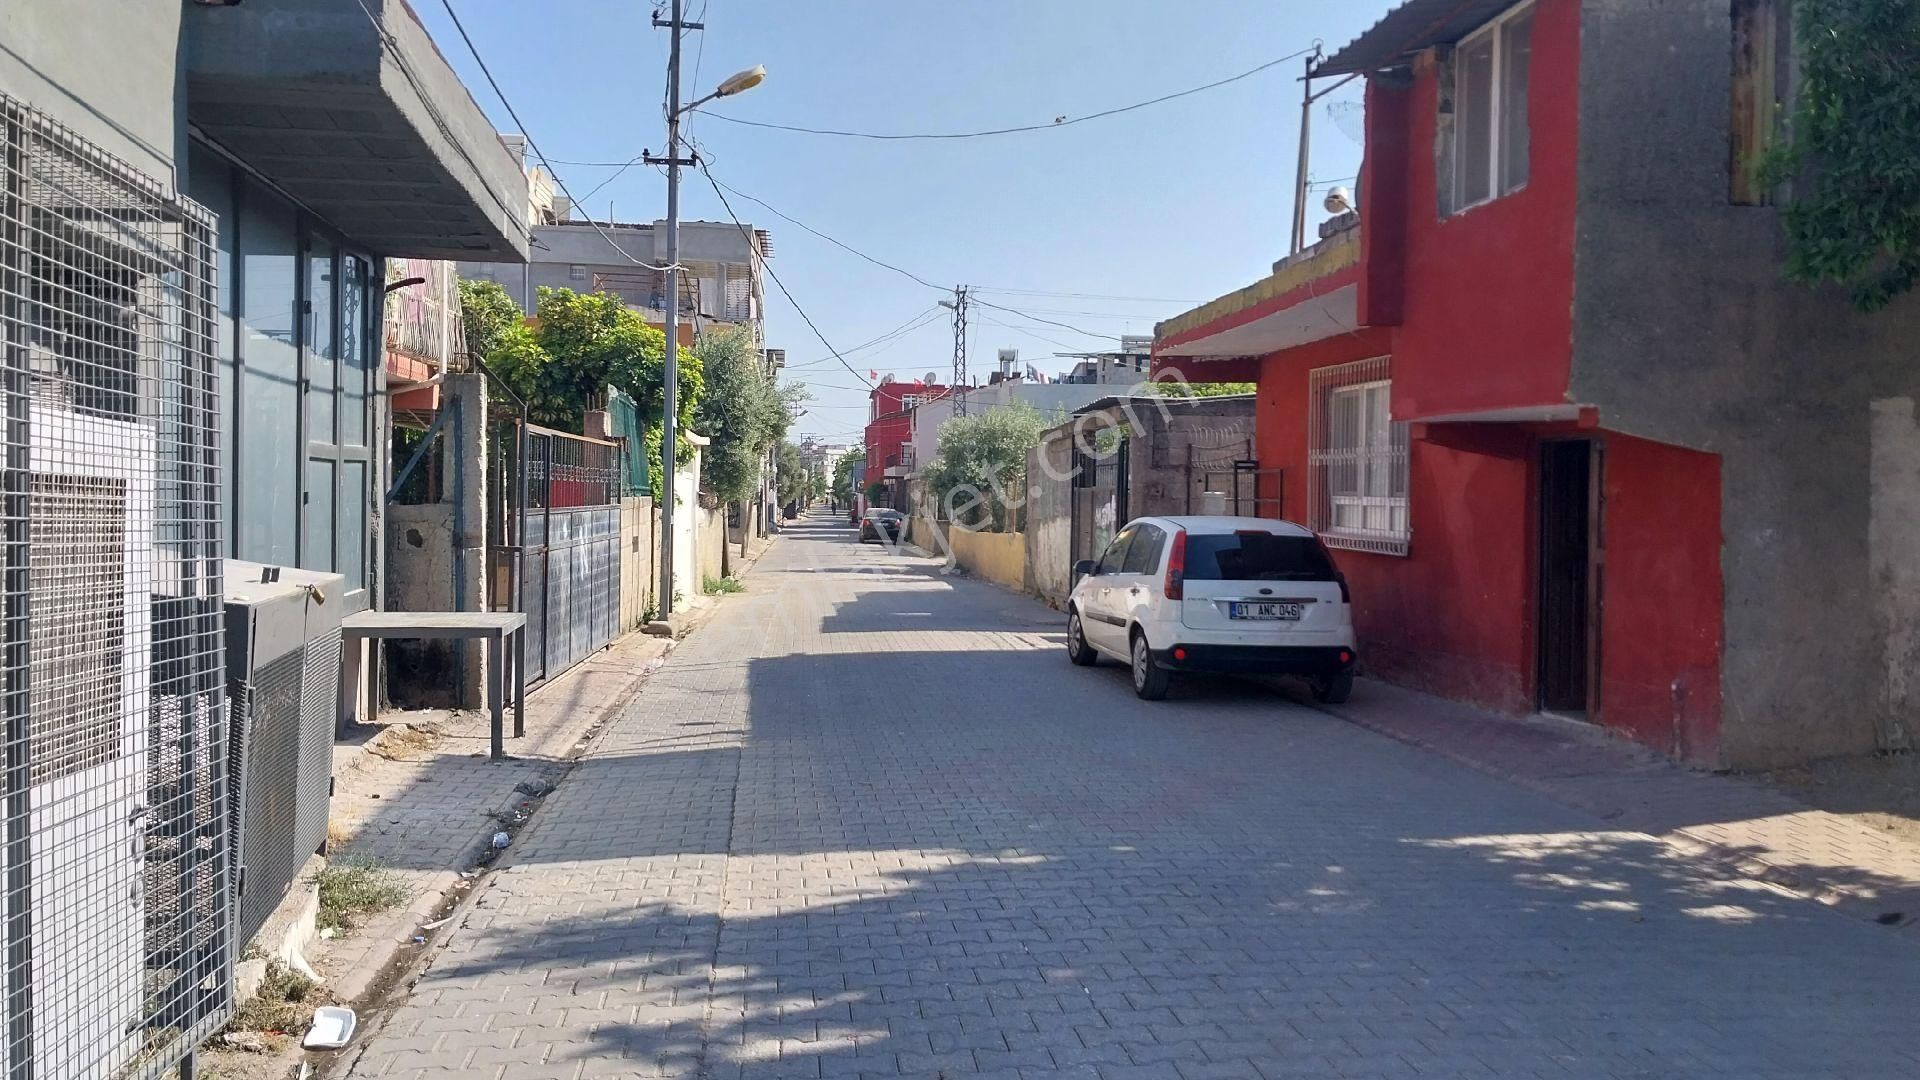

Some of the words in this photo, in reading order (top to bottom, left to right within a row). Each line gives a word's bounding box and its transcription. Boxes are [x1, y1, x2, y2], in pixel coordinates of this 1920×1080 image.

[1237, 604, 1249, 615] 01
[1258, 604, 1276, 615] ANC
[1280, 605, 1297, 616] 046
